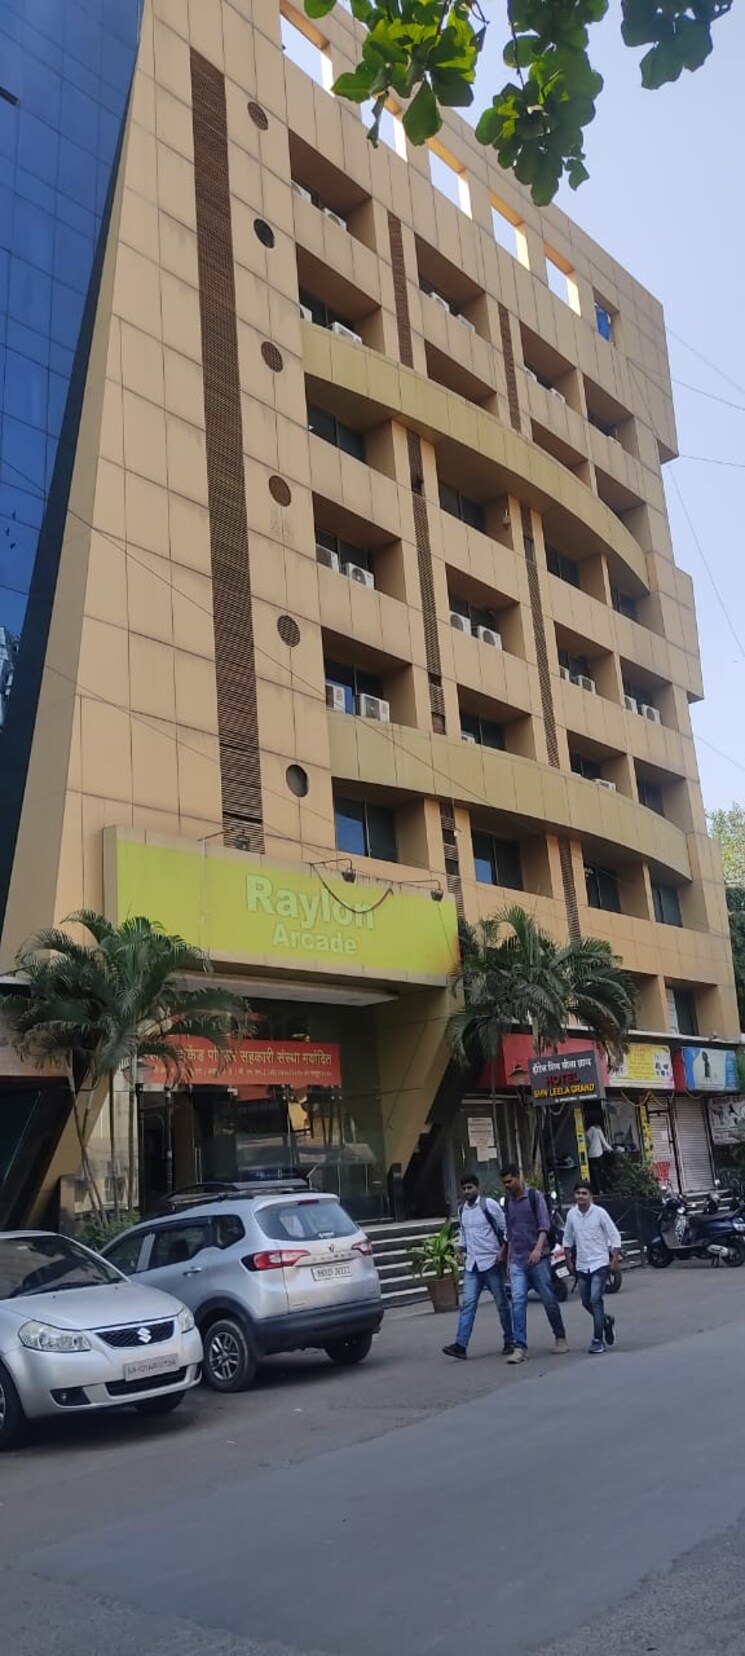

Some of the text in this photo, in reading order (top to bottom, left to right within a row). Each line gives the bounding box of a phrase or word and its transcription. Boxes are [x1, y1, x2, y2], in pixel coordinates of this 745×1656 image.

[246, 874, 375, 930] Raylon
[272, 922, 359, 955] Arcade
[239, 1047, 274, 1065] सहकारी
[546, 1072, 582, 1086] HOTEL
[549, 1086, 571, 1097] LEELA
[571, 1083, 596, 1095] GRAND
